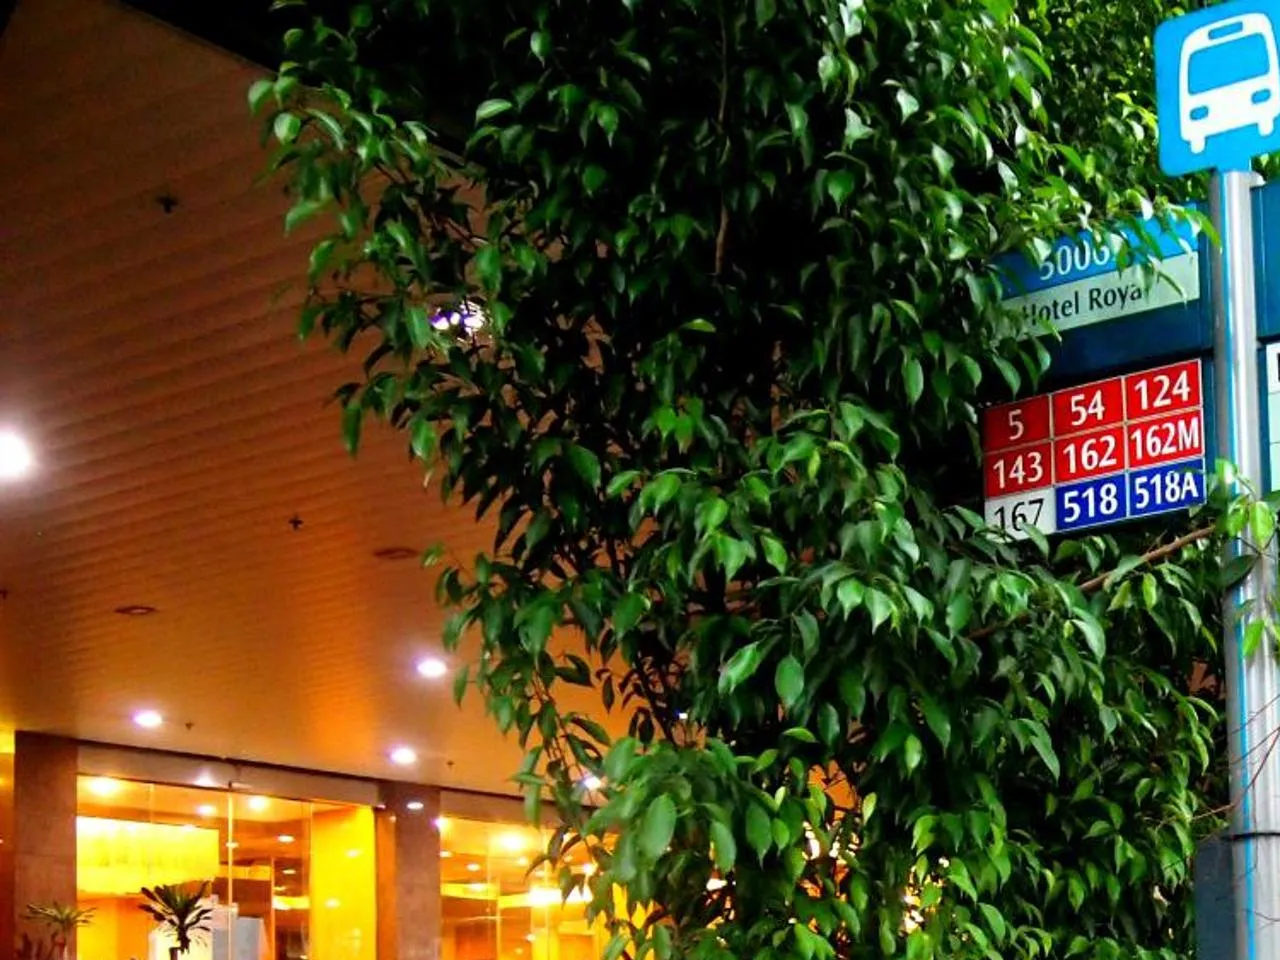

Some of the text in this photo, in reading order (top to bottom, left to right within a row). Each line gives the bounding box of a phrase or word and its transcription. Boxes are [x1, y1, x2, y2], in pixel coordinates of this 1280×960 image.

[1022, 283, 1144, 327] Hotel Roya
[1008, 370, 1192, 440] 5 54 124
[993, 416, 1200, 489] 143 162 162M
[994, 471, 1199, 536] 167 518 518A
